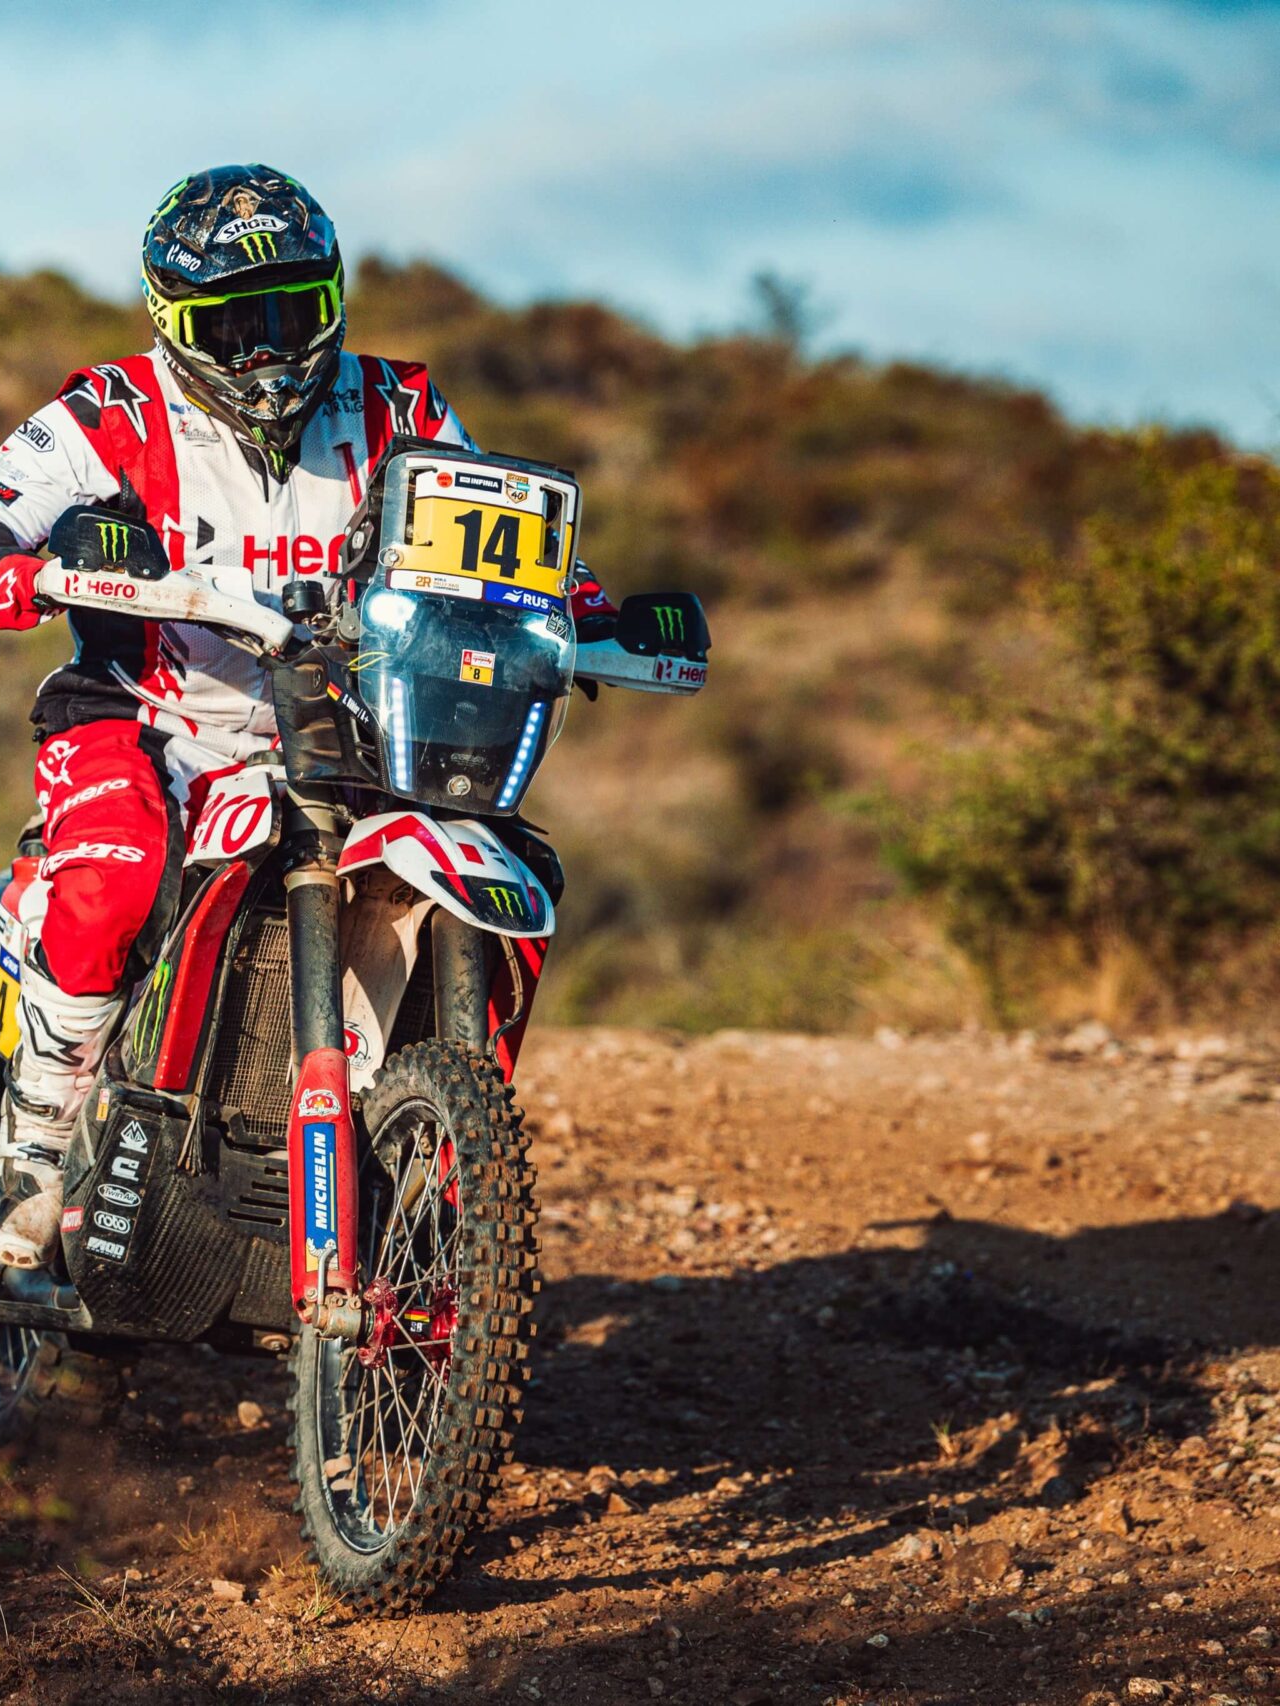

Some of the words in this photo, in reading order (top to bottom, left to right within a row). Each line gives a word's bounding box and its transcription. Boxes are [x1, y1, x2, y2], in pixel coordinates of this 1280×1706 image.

[223, 217, 277, 240] SHOEI
[176, 250, 202, 272] Hero
[18, 419, 52, 449] SHOEI
[470, 477, 499, 489] INFINIA
[511, 491, 524, 501] 40
[454, 509, 520, 579] 14
[87, 580, 136, 599] Hero
[523, 593, 549, 609] RUS
[473, 668, 481, 680] 8
[62, 778, 131, 813] Hero
[313, 1131, 327, 1230] MICHELIN
[103, 1185, 123, 1200] Twin
[123, 1192, 137, 1205] Air
[97, 1214, 128, 1231] roto
